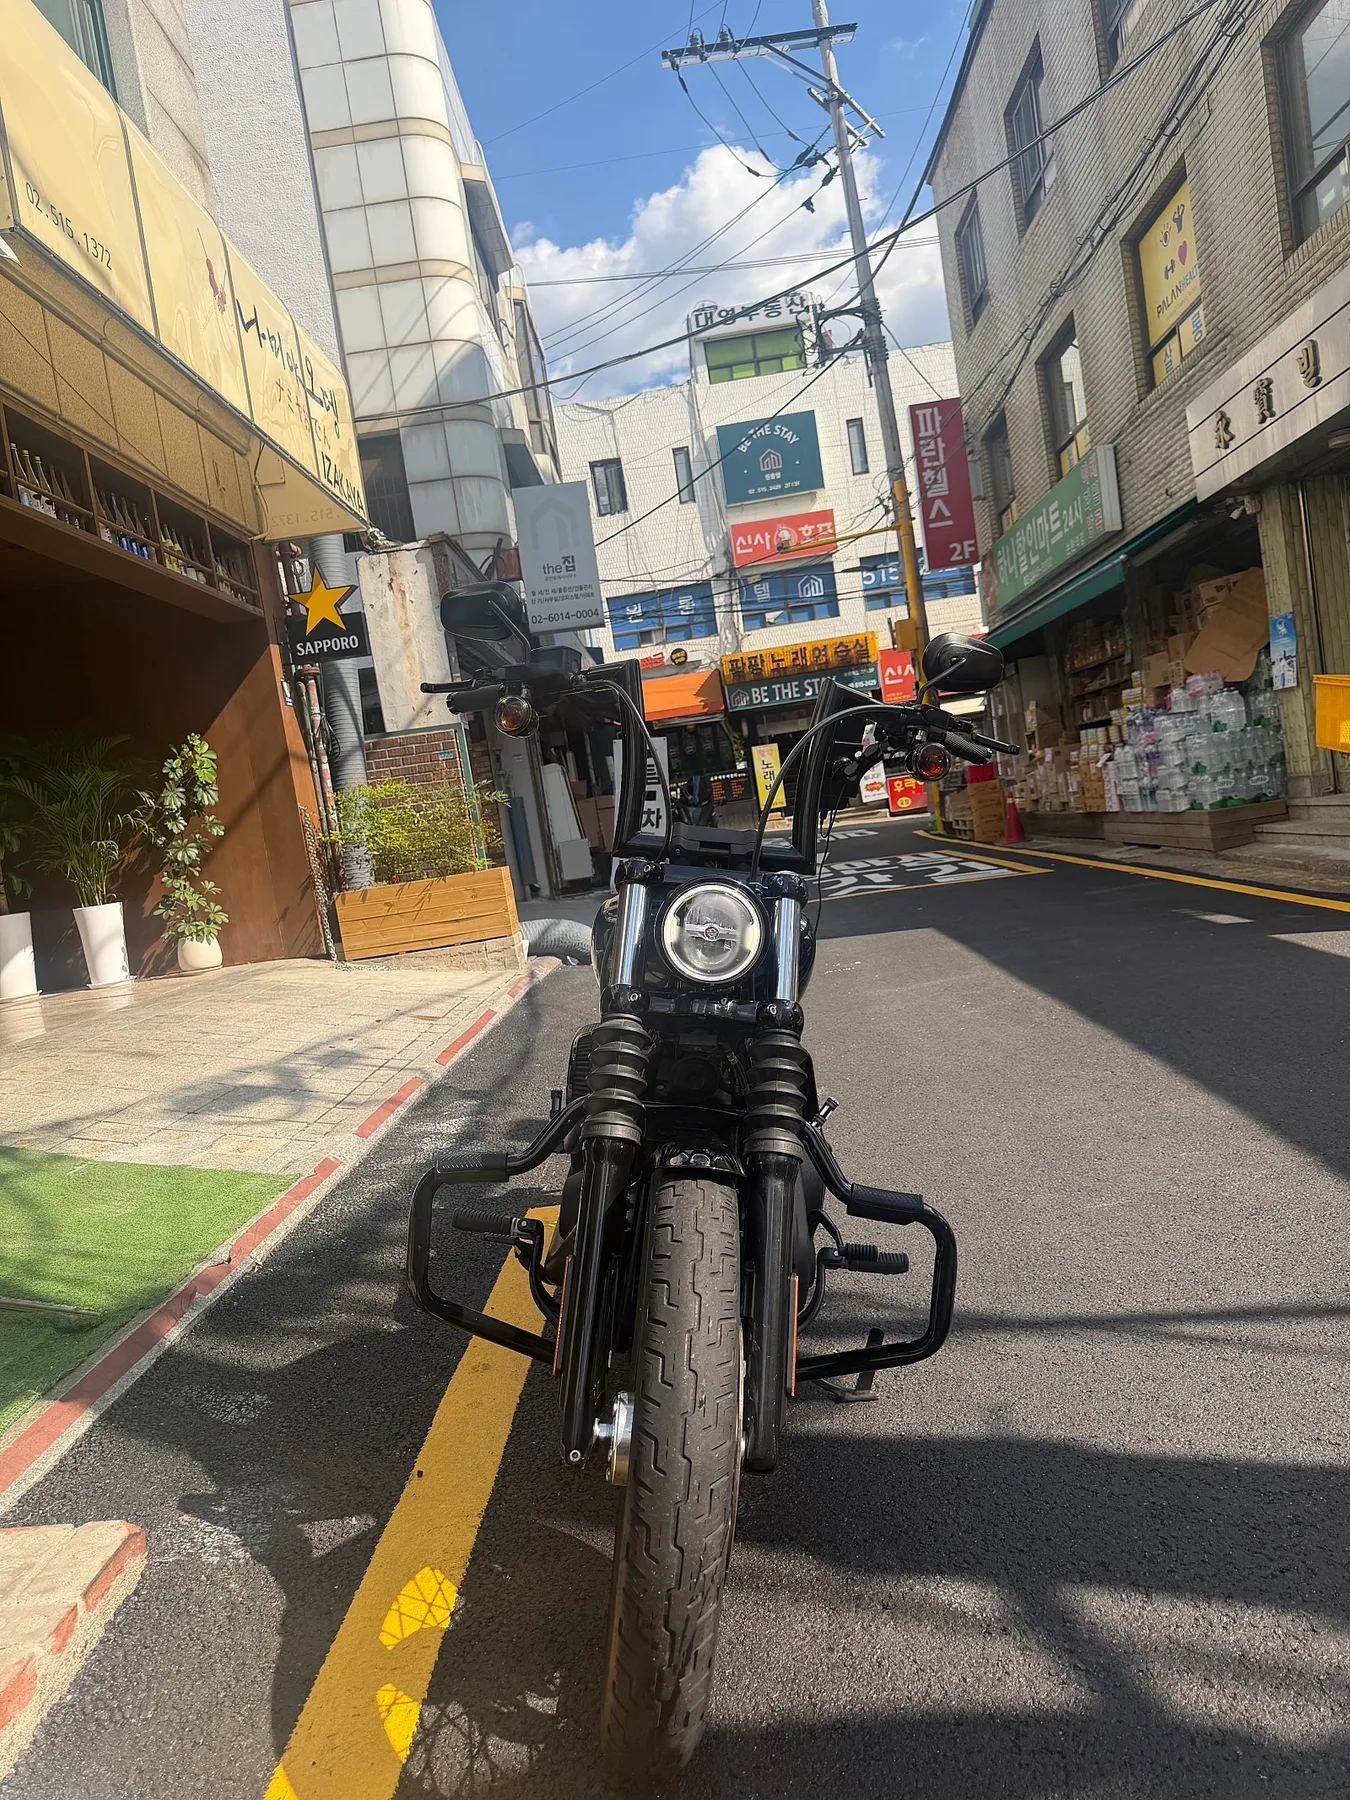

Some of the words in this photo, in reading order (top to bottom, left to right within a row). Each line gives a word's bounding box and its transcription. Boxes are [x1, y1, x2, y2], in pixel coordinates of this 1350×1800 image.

[25, 181, 113, 271] 02.515.1372
[1156, 263, 1200, 319] PALANHEALT
[748, 424, 772, 439] THE
[773, 424, 800, 445] STAY
[915, 406, 954, 529] 파란헬스
[321, 451, 366, 517] IZAKAYA
[736, 531, 771, 555] 신사
[948, 540, 976, 562] 2F
[531, 608, 599, 624] 02-6014-0004
[296, 634, 359, 657] SAPPORO
[751, 687, 770, 705] BE
[772, 681, 801, 701] THE
[803, 674, 836, 697] ST
